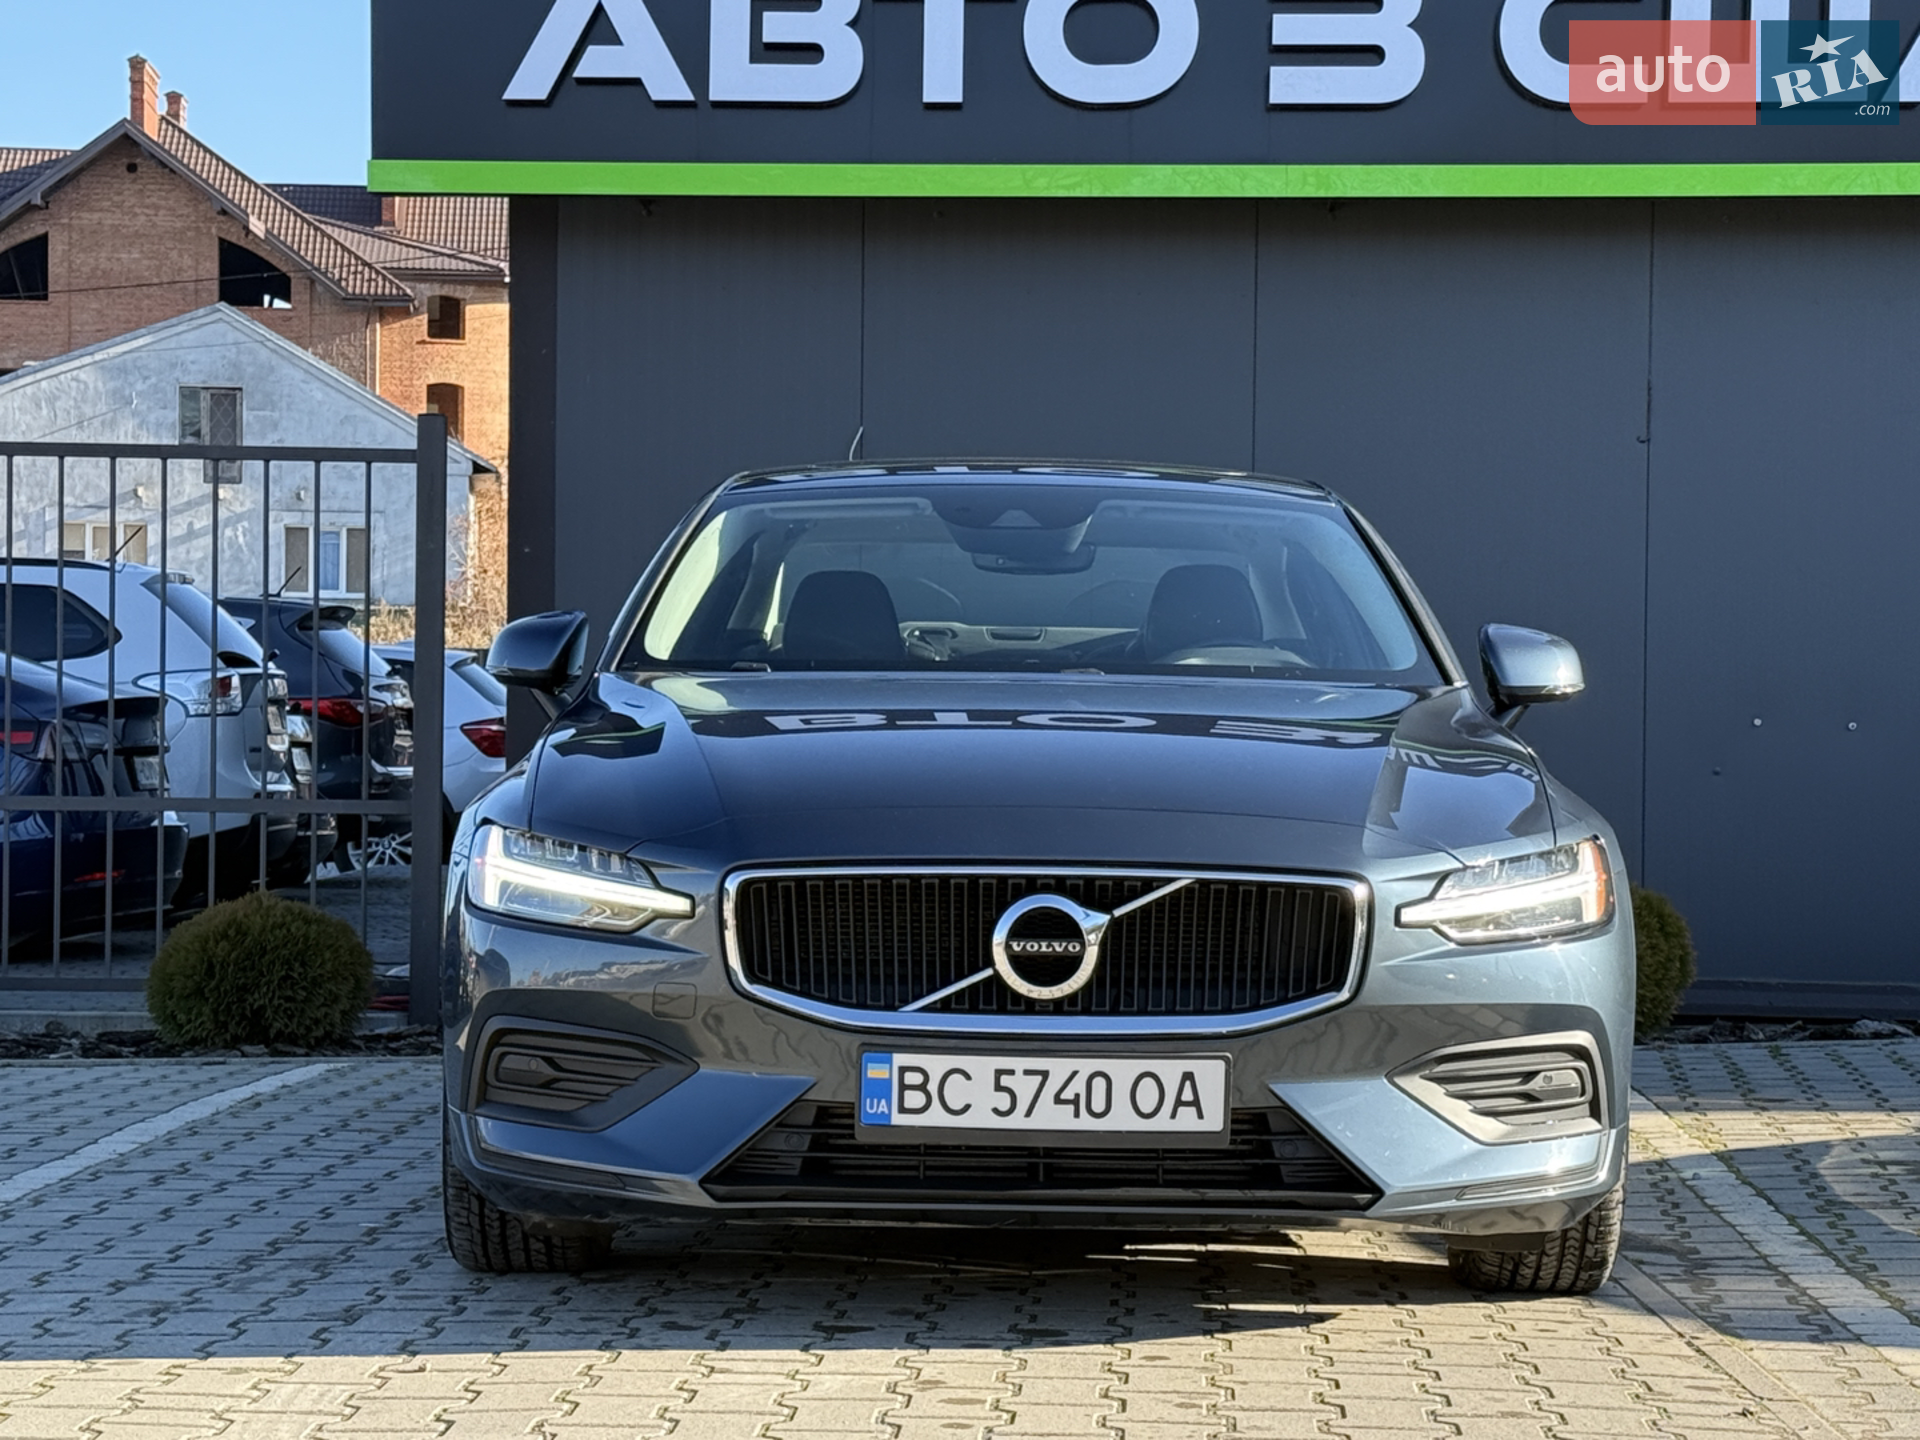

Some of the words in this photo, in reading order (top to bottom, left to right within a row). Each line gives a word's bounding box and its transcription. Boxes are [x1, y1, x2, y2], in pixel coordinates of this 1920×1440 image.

[1009, 941, 1081, 952] VOLVO
[897, 1066, 974, 1116] BC
[991, 1069, 1113, 1119] 5740
[1130, 1071, 1204, 1120] OA
[866, 1099, 889, 1114] UA
